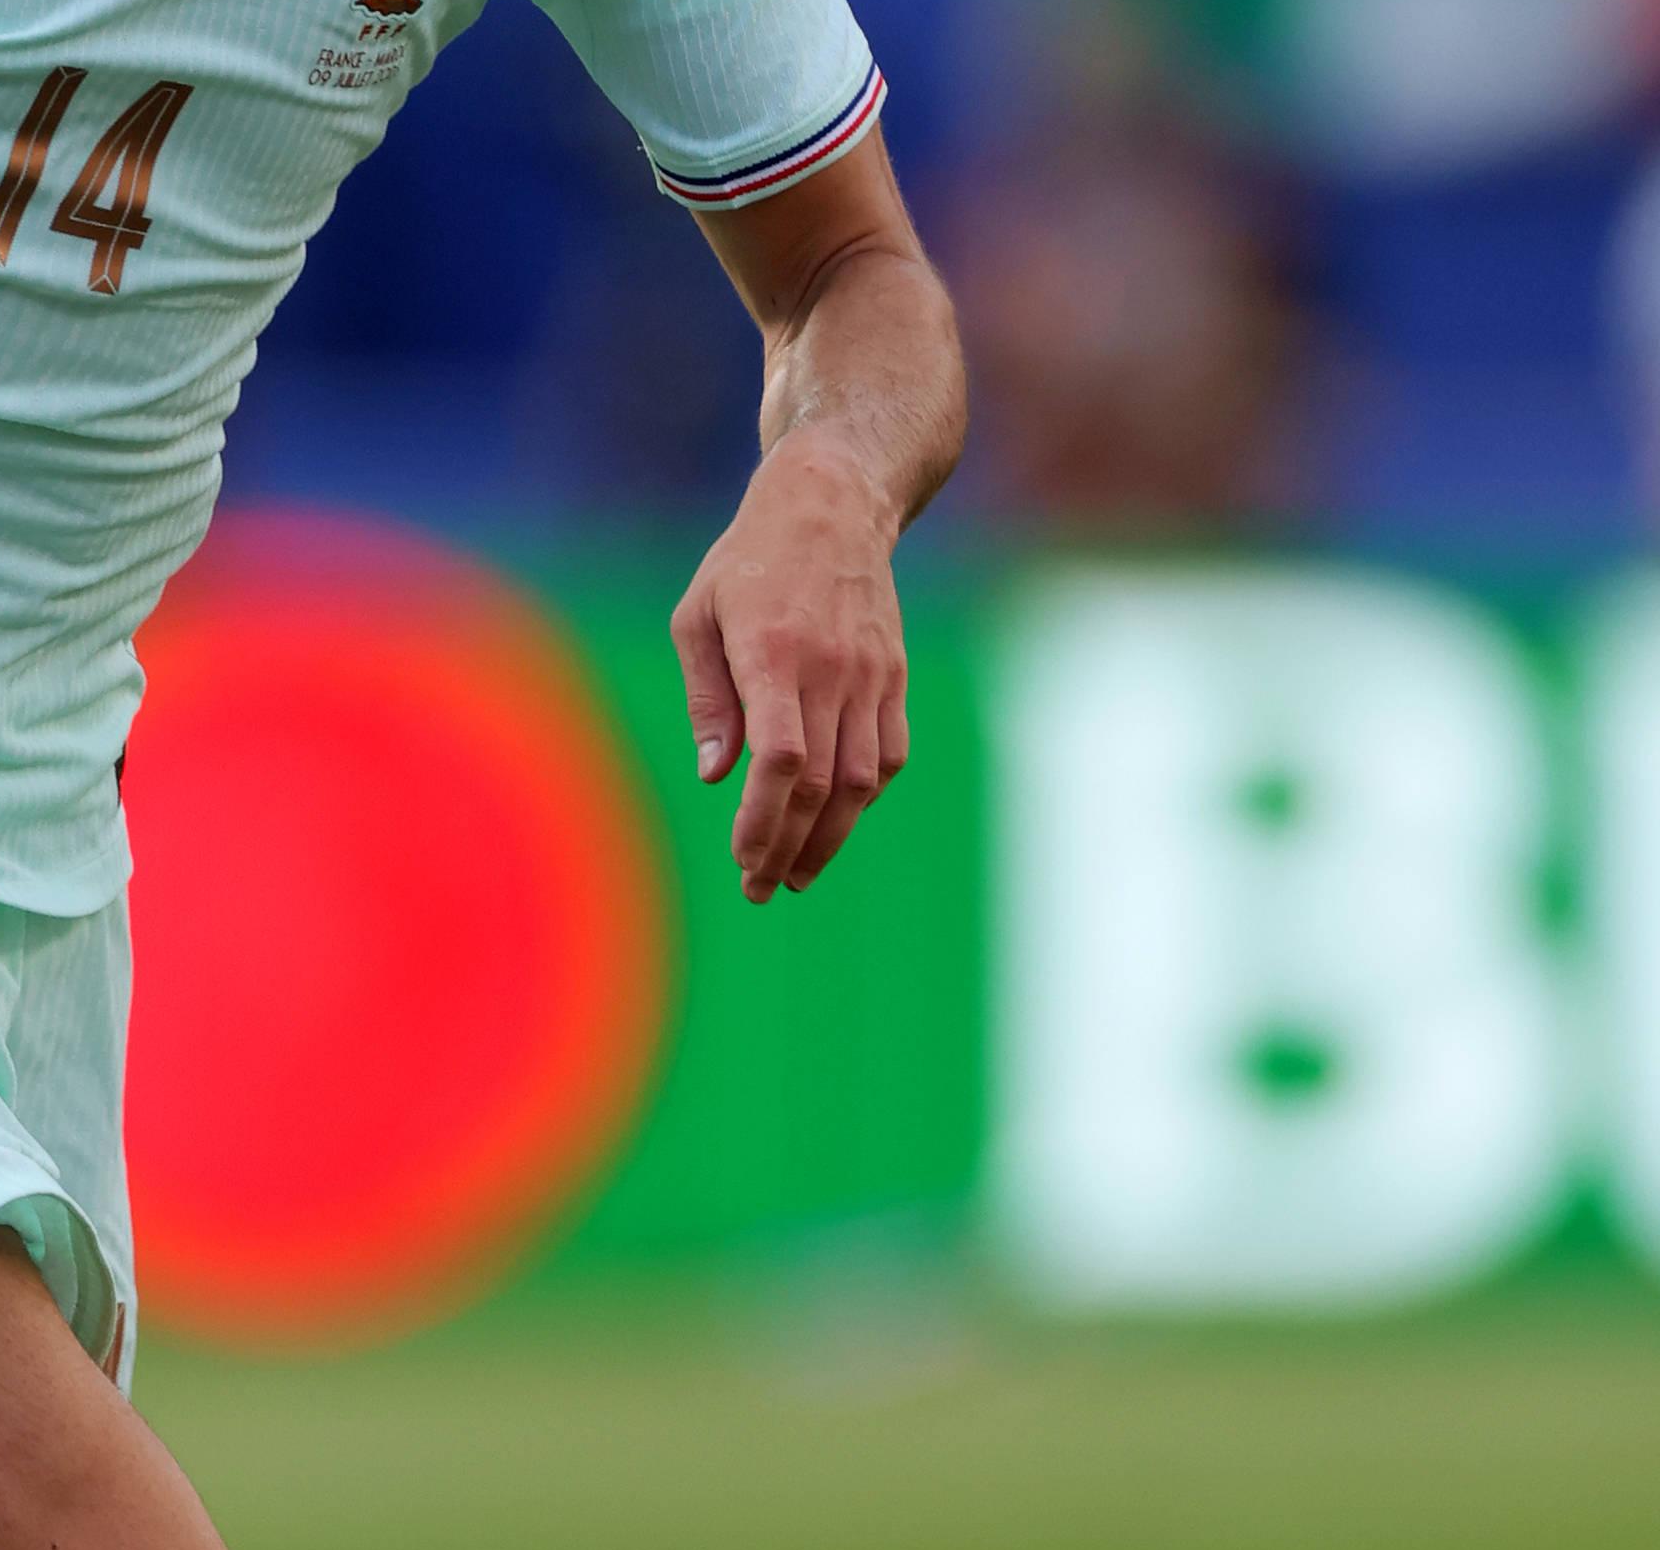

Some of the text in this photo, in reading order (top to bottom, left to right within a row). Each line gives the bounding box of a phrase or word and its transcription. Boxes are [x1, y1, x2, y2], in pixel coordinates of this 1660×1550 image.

[358, 23, 407, 41] FFF
[316, 48, 366, 68] FRANCE
[308, 68, 332, 86] 09
